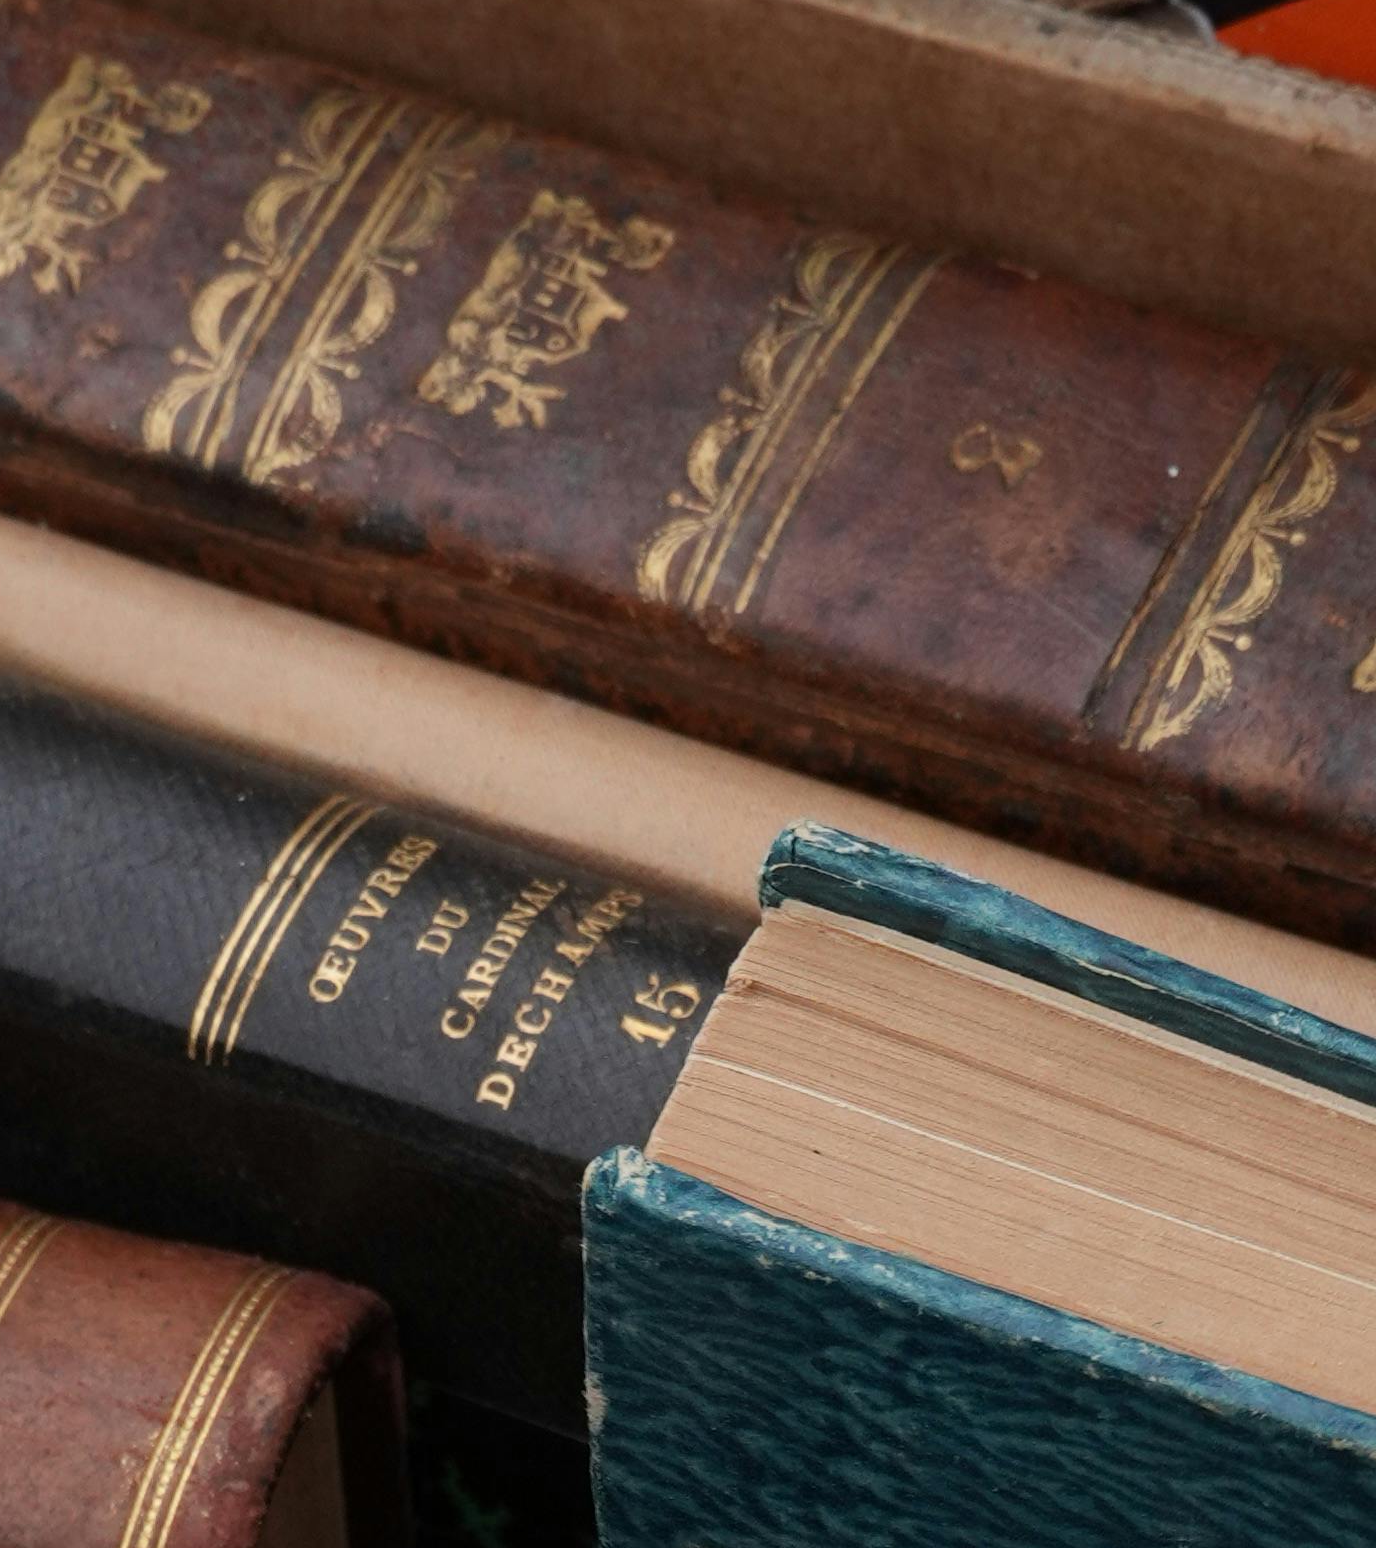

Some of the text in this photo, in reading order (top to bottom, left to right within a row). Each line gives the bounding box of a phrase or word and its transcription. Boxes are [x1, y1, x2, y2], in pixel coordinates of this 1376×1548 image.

[414, 898, 472, 958] DU
[439, 876, 569, 1041] CARDINAL
[475, 887, 646, 1112] DECHAMPS
[618, 971, 703, 1050] 15
